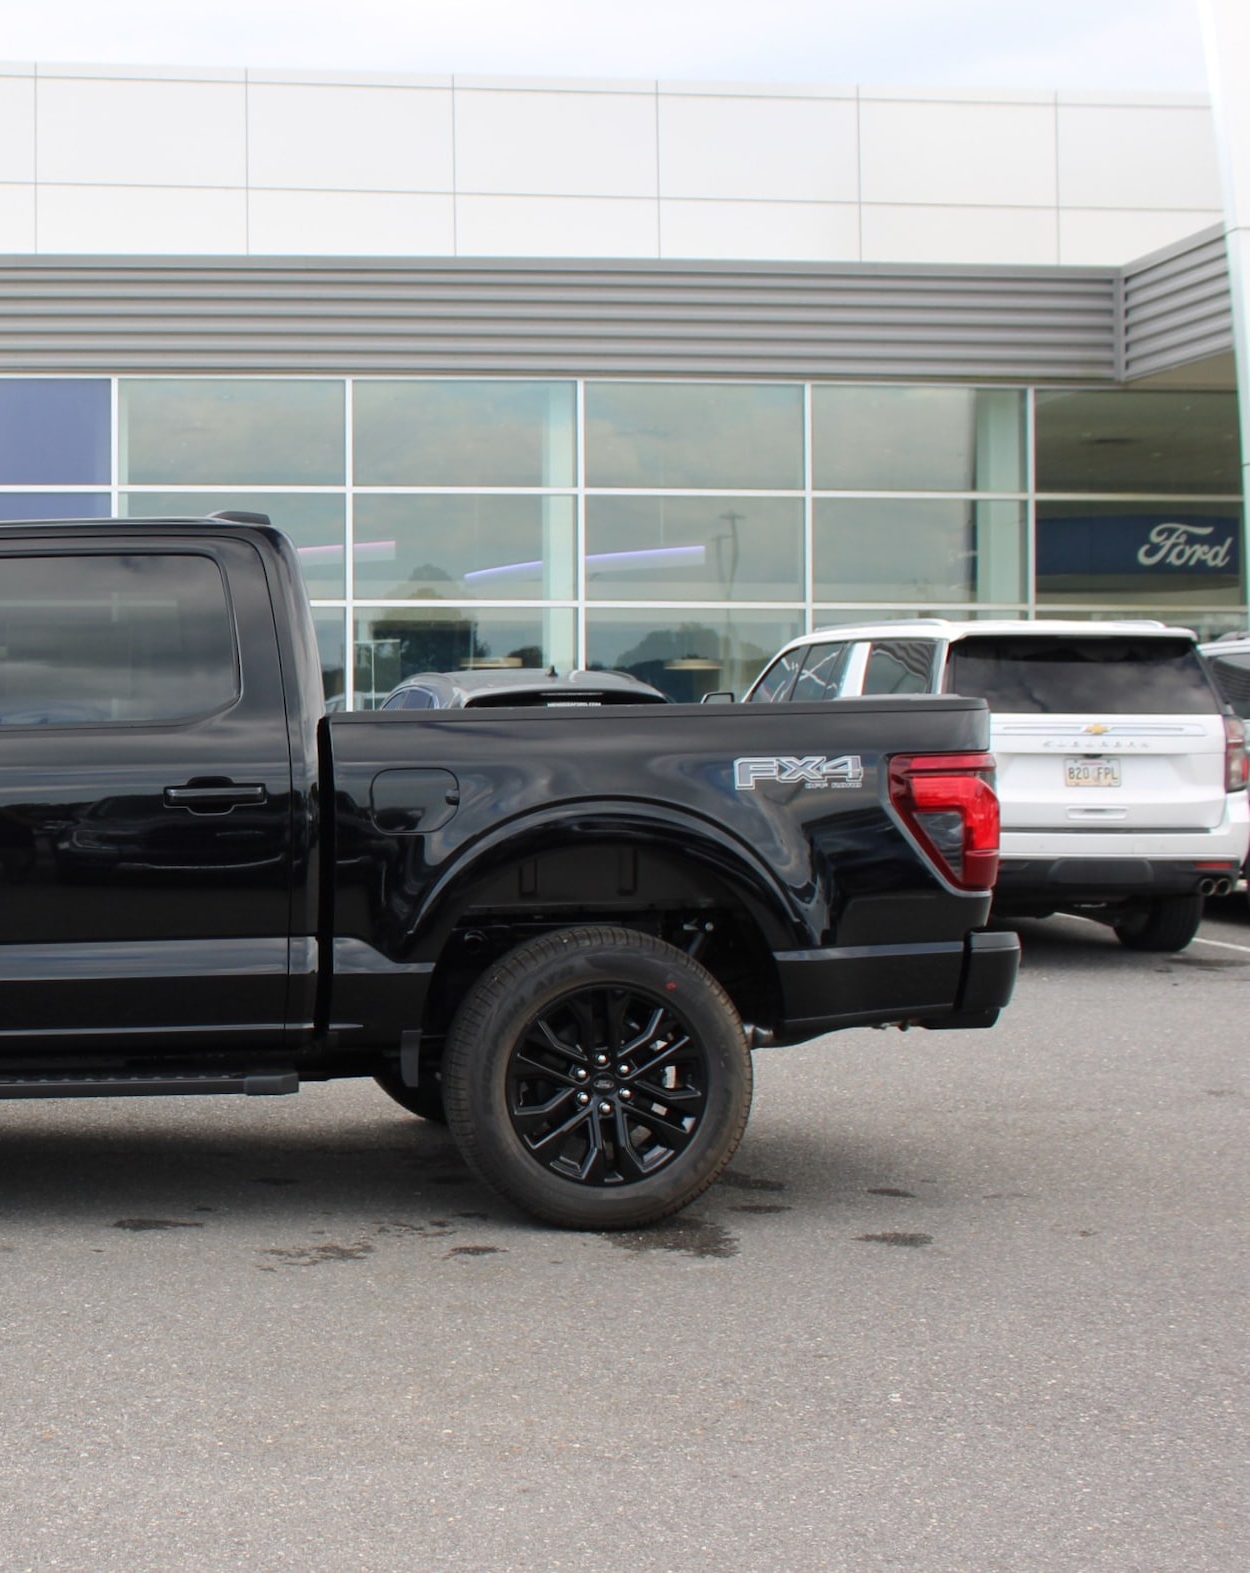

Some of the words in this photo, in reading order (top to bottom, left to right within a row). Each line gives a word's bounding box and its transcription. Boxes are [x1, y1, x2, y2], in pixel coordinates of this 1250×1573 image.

[1137, 522, 1234, 567] Ford
[734, 755, 864, 790] FX4
[1068, 766, 1090, 780] 820
[1097, 767, 1119, 780] FPL
